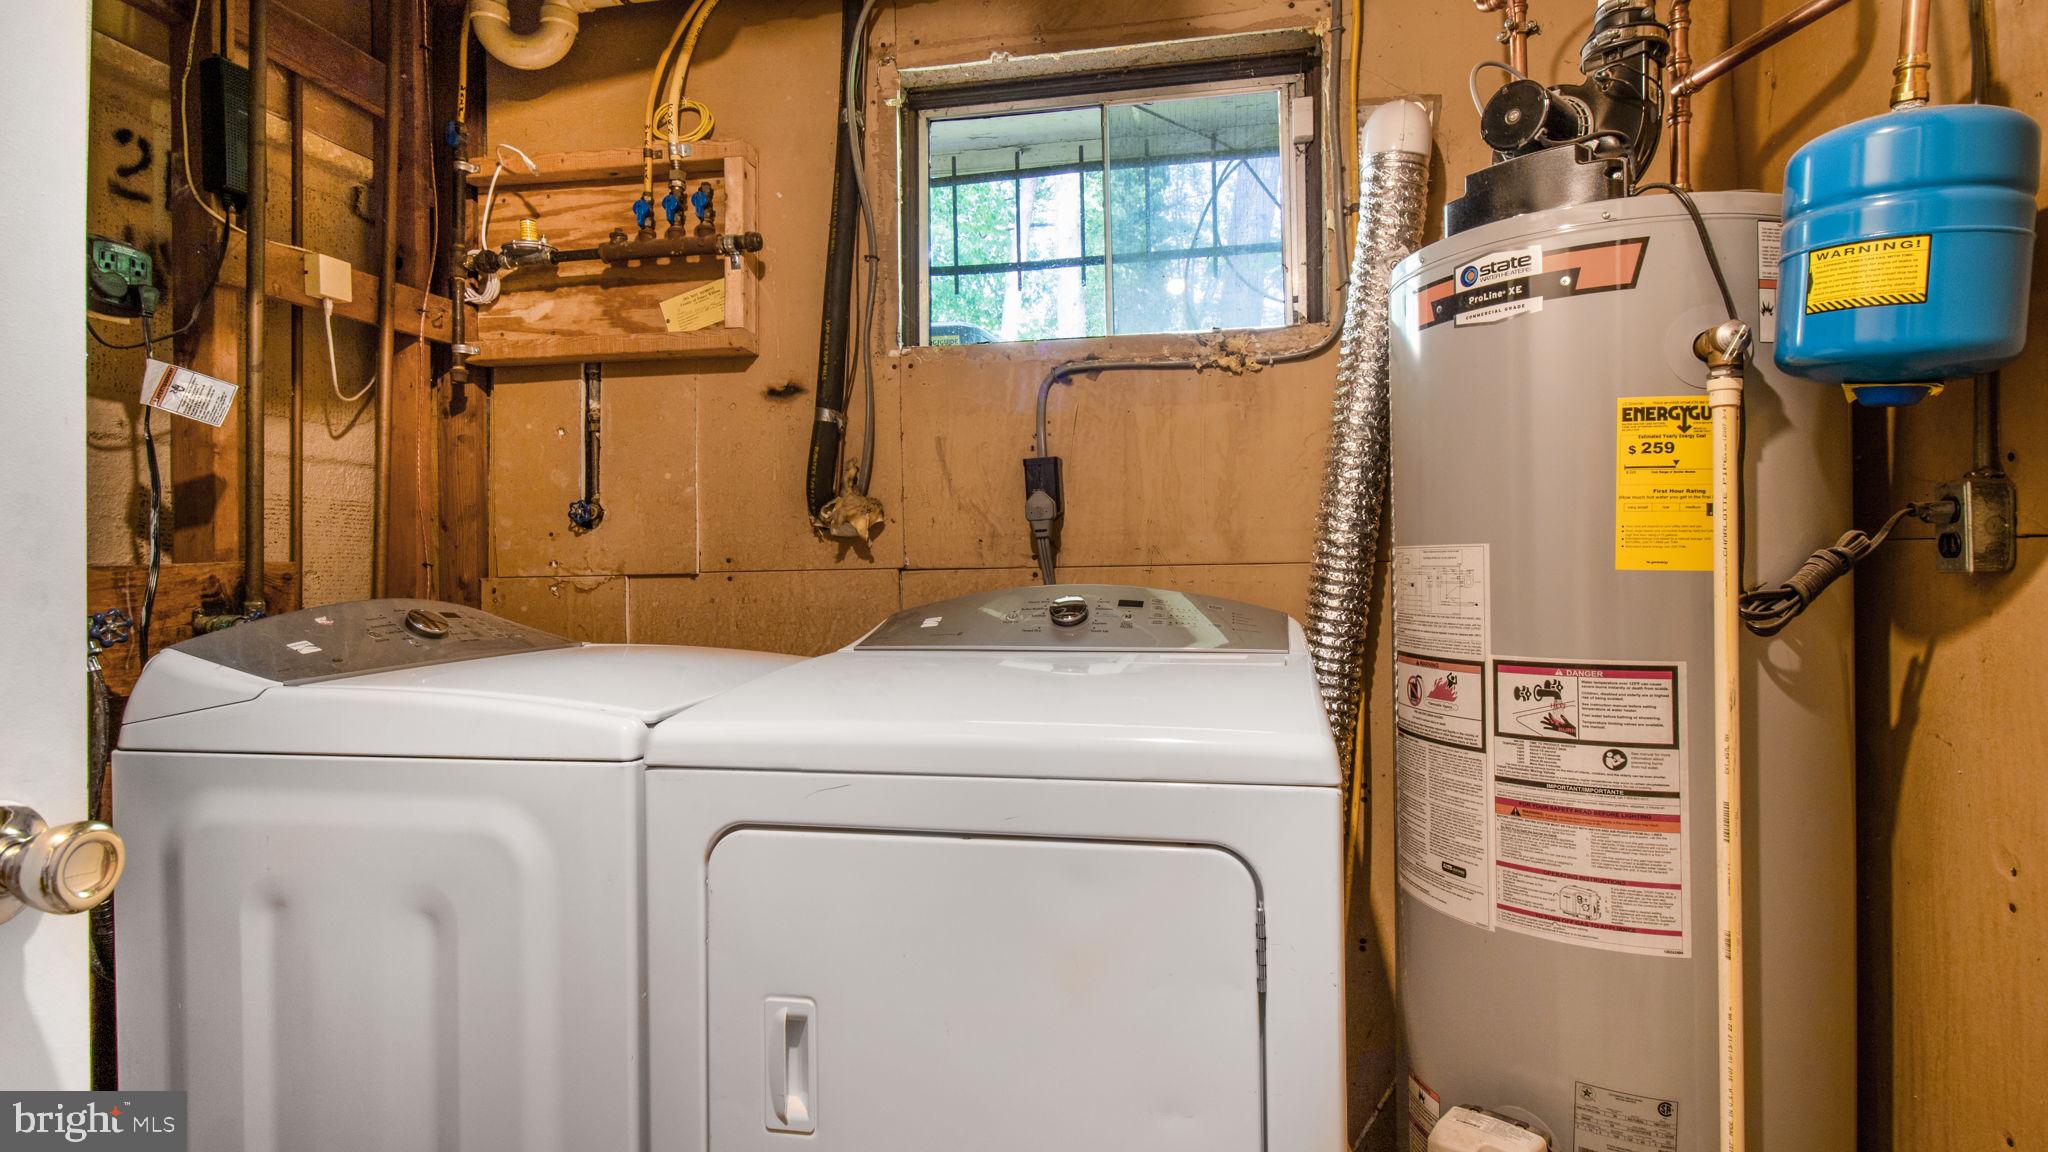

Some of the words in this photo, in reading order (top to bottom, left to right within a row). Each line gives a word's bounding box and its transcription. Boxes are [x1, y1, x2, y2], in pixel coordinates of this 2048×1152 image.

[1816, 239, 1921, 261] WARNING!
[1479, 255, 1532, 277] state
[1508, 285, 1522, 295] XE
[1466, 308, 1501, 320] COMMERCIAL
[1504, 303, 1525, 312] GRADE
[1628, 445, 1637, 455] $
[1641, 441, 1675, 454] 259
[1566, 670, 1604, 678] DANGER
[1546, 783, 1624, 794] IMPORTANT/IMPORTANTE
[1549, 804, 1572, 813] SAFETY
[1573, 807, 1592, 815] READ
[1594, 809, 1620, 818] BEFORE
[1621, 812, 1652, 820] LIGHTING
[1543, 869, 1578, 880] OPERATING
[1580, 875, 1626, 886] INSTRUCTIONS
